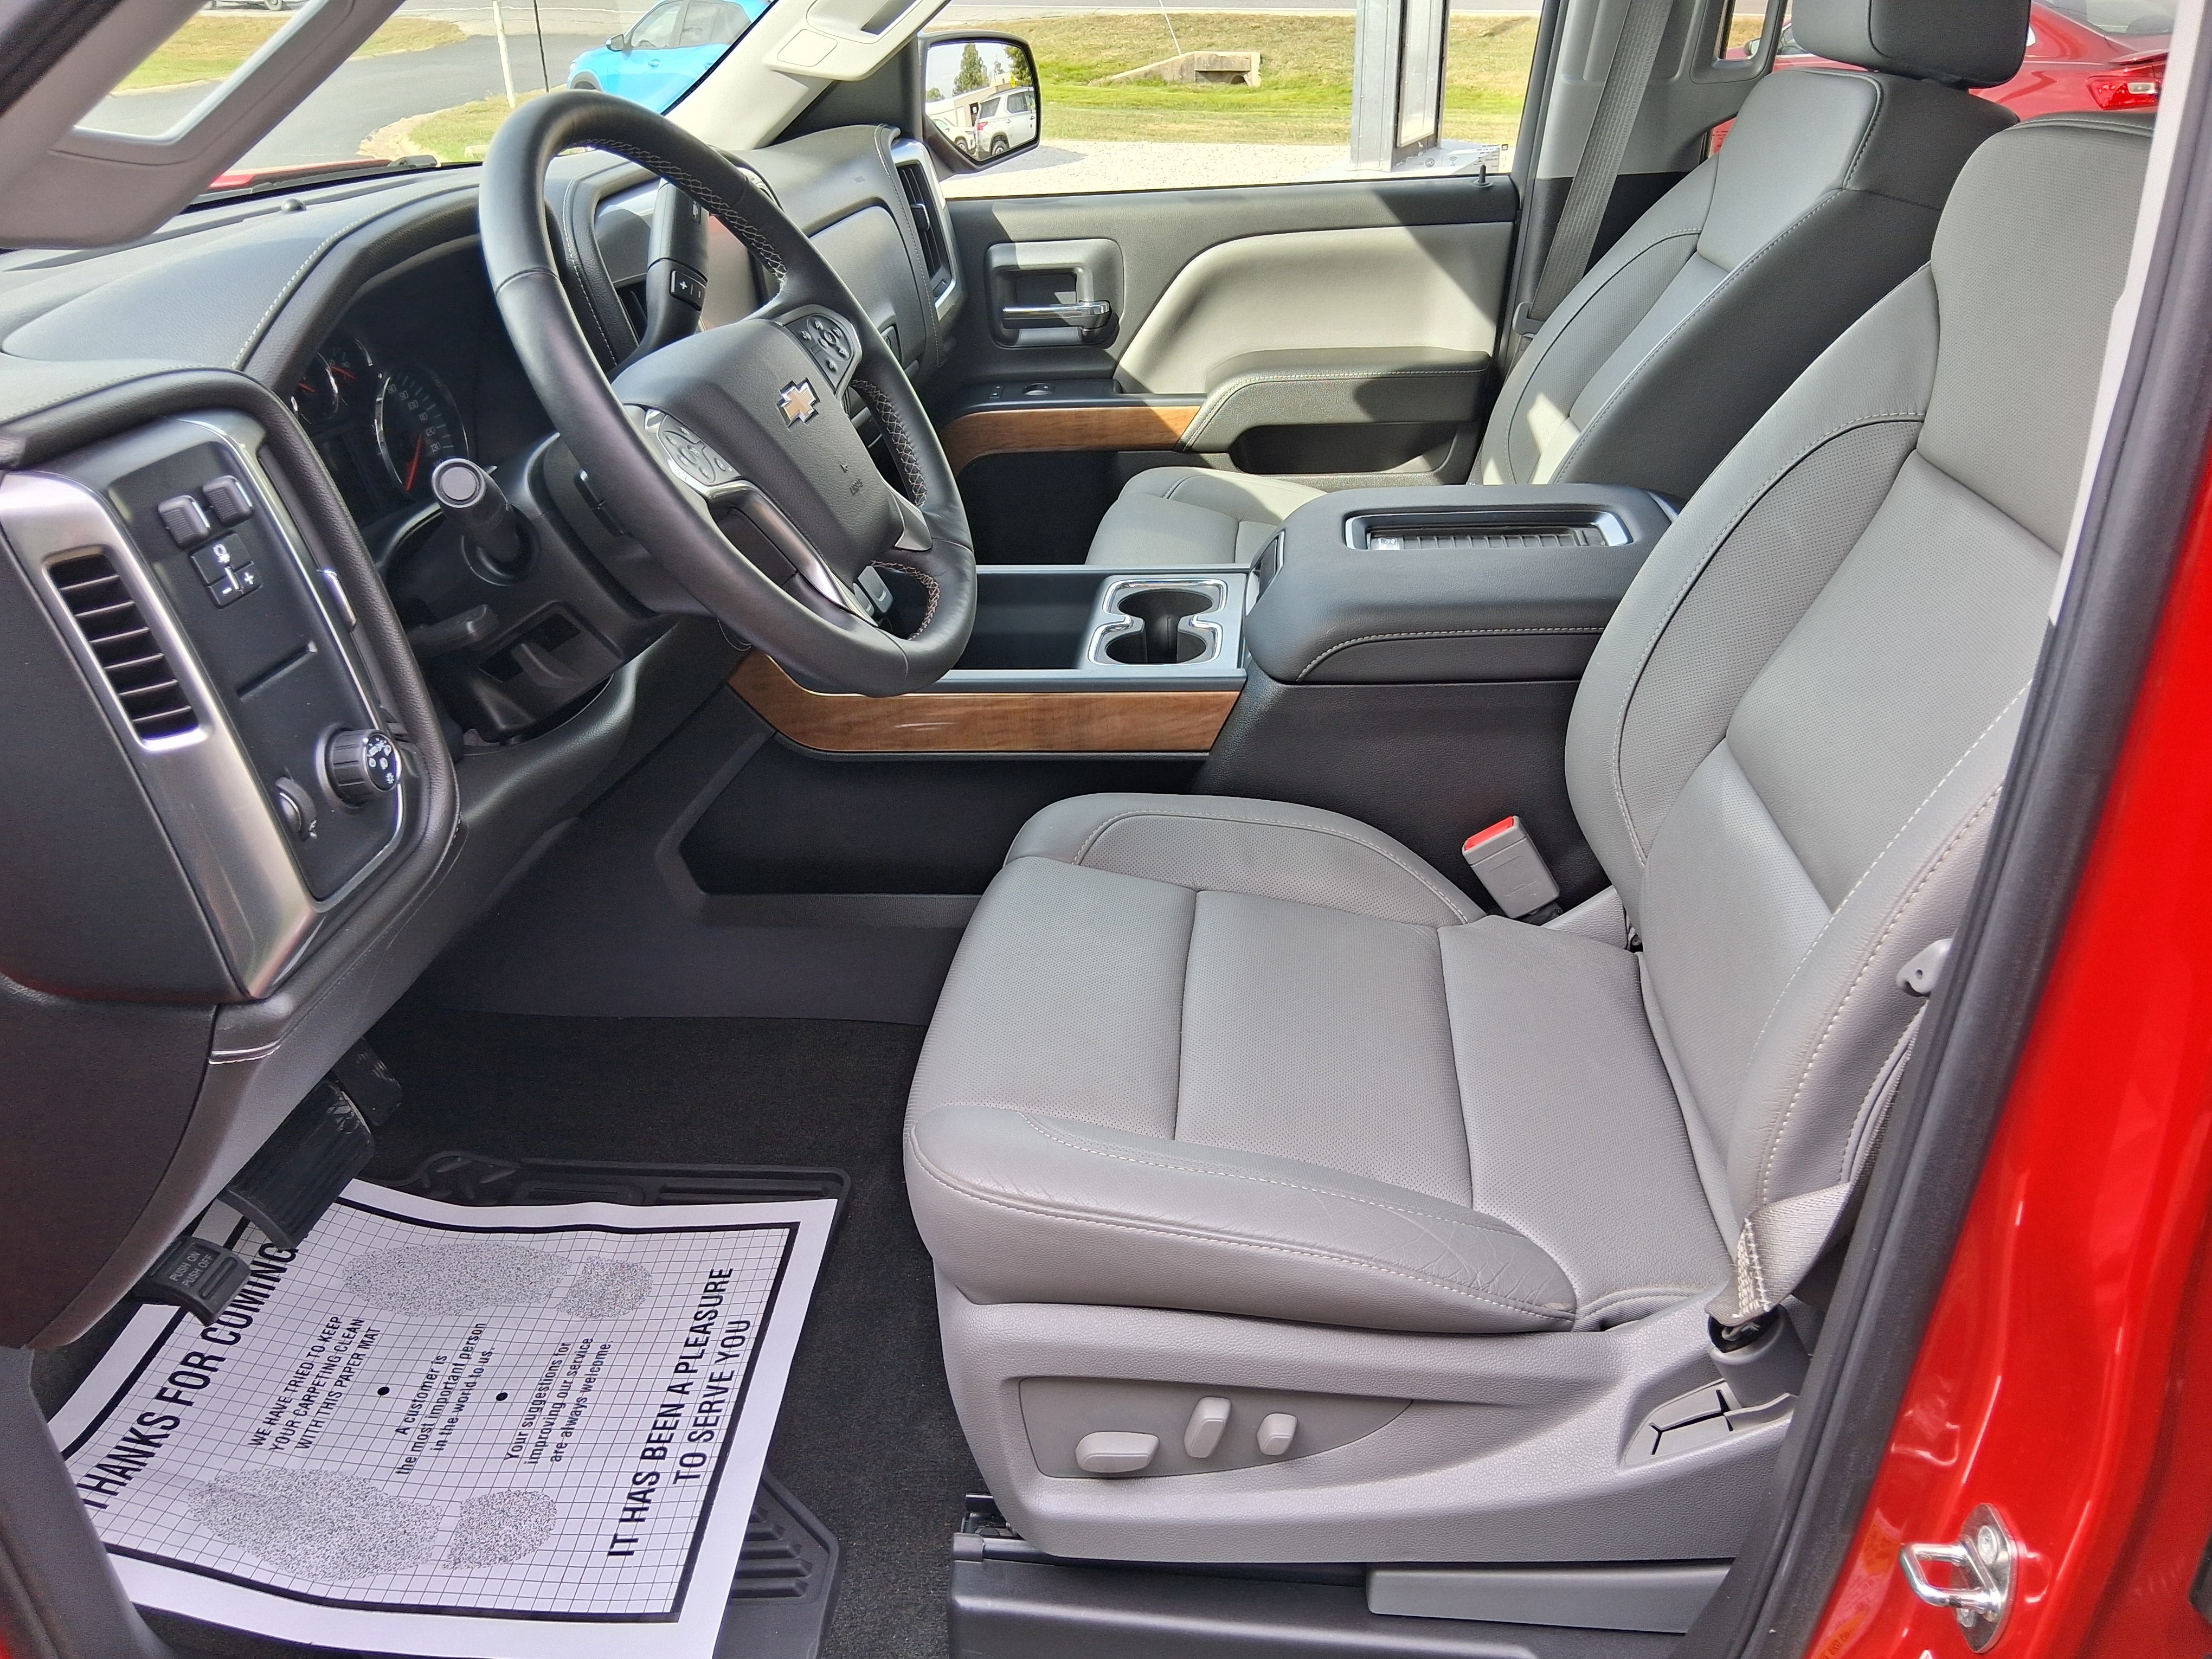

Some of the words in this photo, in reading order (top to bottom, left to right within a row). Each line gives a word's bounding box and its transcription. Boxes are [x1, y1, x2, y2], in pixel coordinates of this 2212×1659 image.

[399, 390, 409, 400] 90
[408, 400, 419, 410] 100
[425, 426, 435, 436] 120
[430, 442, 441, 452] 130
[169, 1262, 191, 1281] PUSH
[187, 1251, 201, 1262] ON
[182, 1268, 203, 1287] PUSH
[198, 1253, 214, 1268] OFF
[673, 1268, 734, 1373] PLEASURE
[715, 1320, 750, 1364] YOU
[155, 1351, 227, 1406] FOR
[247, 1427, 272, 1446] WE
[263, 1396, 292, 1425] HAVE
[283, 1362, 314, 1393] TRIED
[306, 1345, 325, 1358] TO
[317, 1316, 343, 1342] KEEP
[268, 1420, 301, 1450] YOUR
[293, 1355, 343, 1417] CARPETING
[333, 1319, 365, 1352] CLEAN
[295, 1420, 325, 1449] WITH
[316, 1391, 343, 1416] THIS
[334, 1353, 366, 1388] PAPER
[357, 1327, 381, 1349] MAT
[395, 1426, 411, 1436] A
[404, 1368, 440, 1423] customer
[431, 1355, 448, 1365] is
[395, 1456, 417, 1475] the
[410, 1423, 435, 1452] most
[425, 1362, 465, 1419] important
[459, 1323, 486, 1360] person
[430, 1439, 448, 1451] in
[439, 1417, 459, 1436] the
[452, 1381, 477, 1413] world
[468, 1368, 485, 1379] to
[478, 1347, 495, 1364] us.
[504, 1431, 529, 1460] Your
[522, 1359, 563, 1427] suggestions
[552, 1342, 571, 1356] for
[524, 1402, 566, 1464] improving
[557, 1379, 573, 1398] our
[567, 1338, 593, 1377] service
[667, 1381, 694, 1395] A
[687, 1370, 734, 1442] SERVE
[550, 1442, 568, 1462] are
[561, 1397, 588, 1438] always
[640, 1403, 685, 1460] BEEN
[672, 1452, 707, 1484] TO
[619, 1471, 660, 1522] HAS
[607, 1533, 639, 1557] IT
